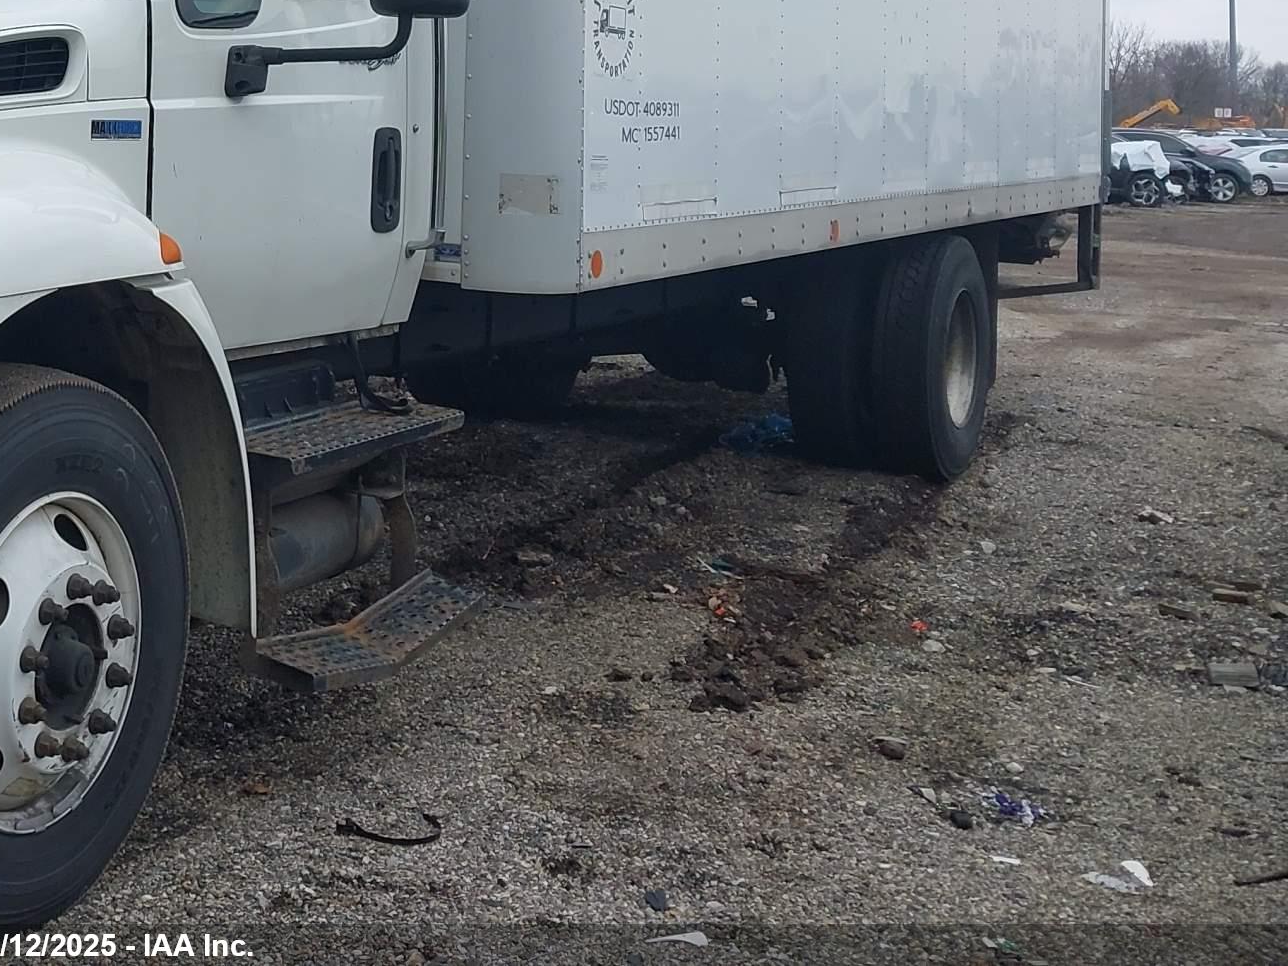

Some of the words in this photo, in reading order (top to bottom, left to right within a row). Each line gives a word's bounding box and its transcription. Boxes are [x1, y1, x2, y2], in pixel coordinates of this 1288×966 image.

[593, 20, 635, 78] TRANSPORTATION
[643, 101, 680, 117] 4089311
[644, 126, 680, 142] 1557441
